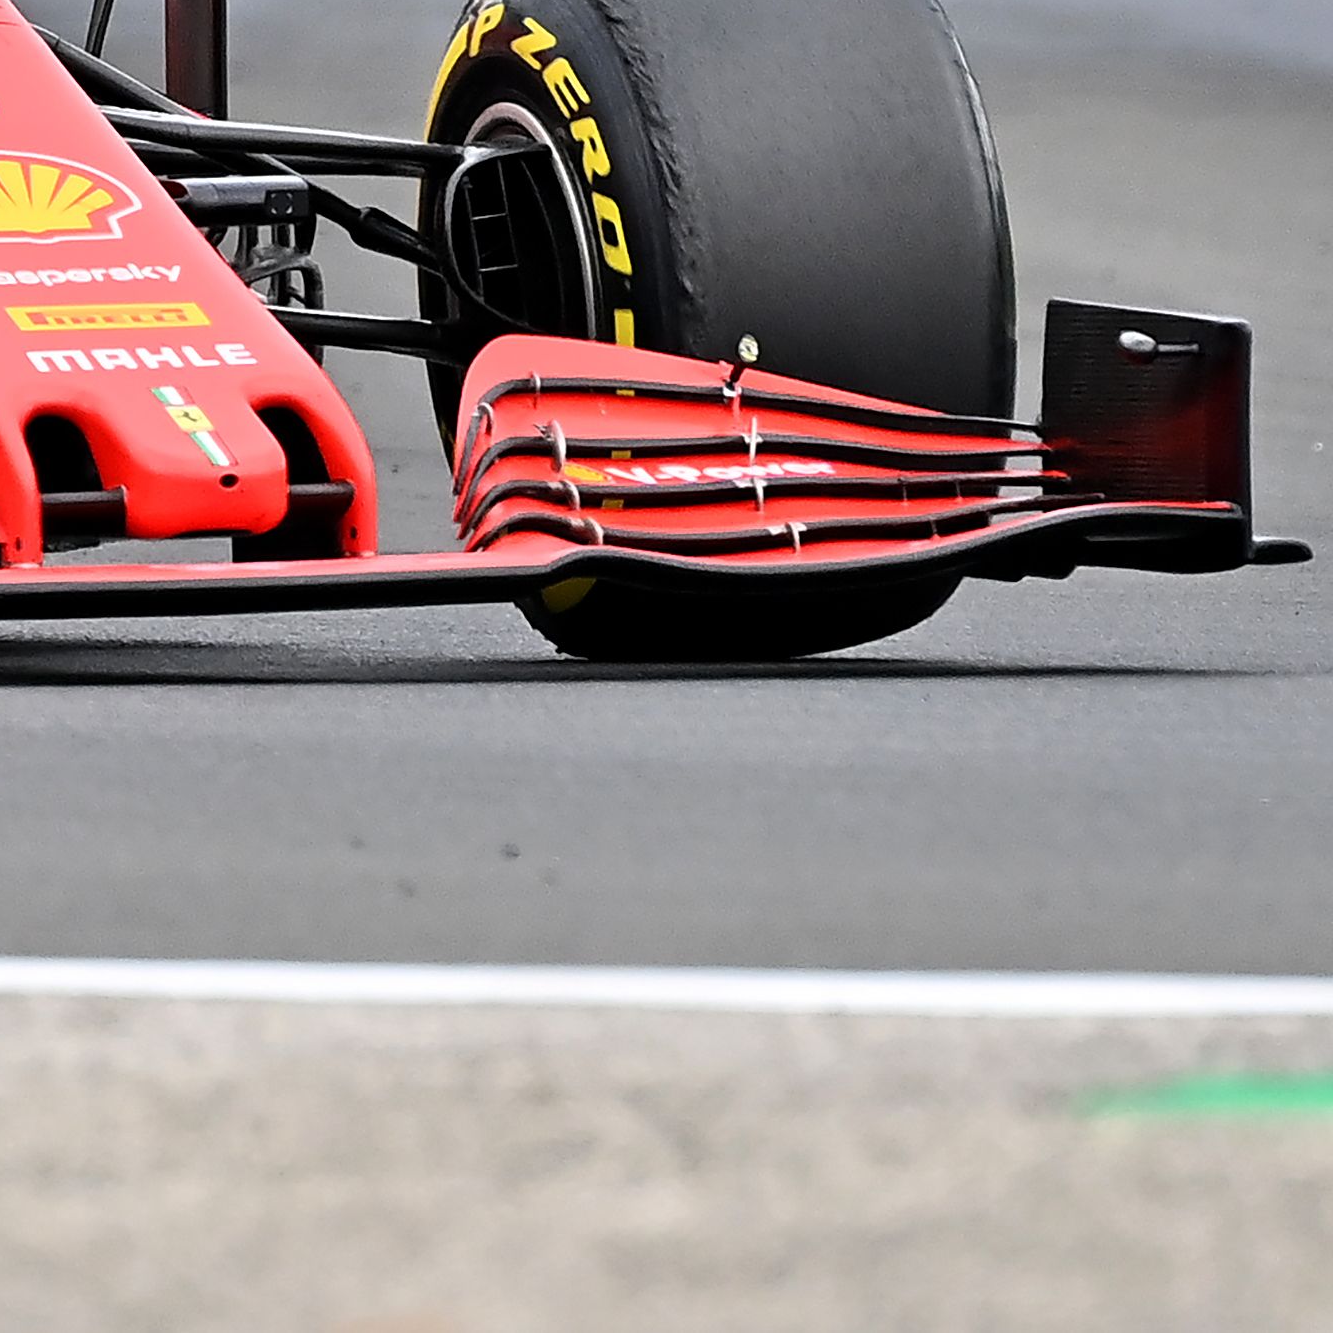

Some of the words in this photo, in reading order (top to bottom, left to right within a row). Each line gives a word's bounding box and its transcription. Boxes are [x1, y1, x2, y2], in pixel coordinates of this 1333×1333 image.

[469, 3, 505, 57] P
[510, 17, 633, 275] ZERO
[25, 343, 259, 372] MAHLE
[604, 462, 836, 484] V-Power
